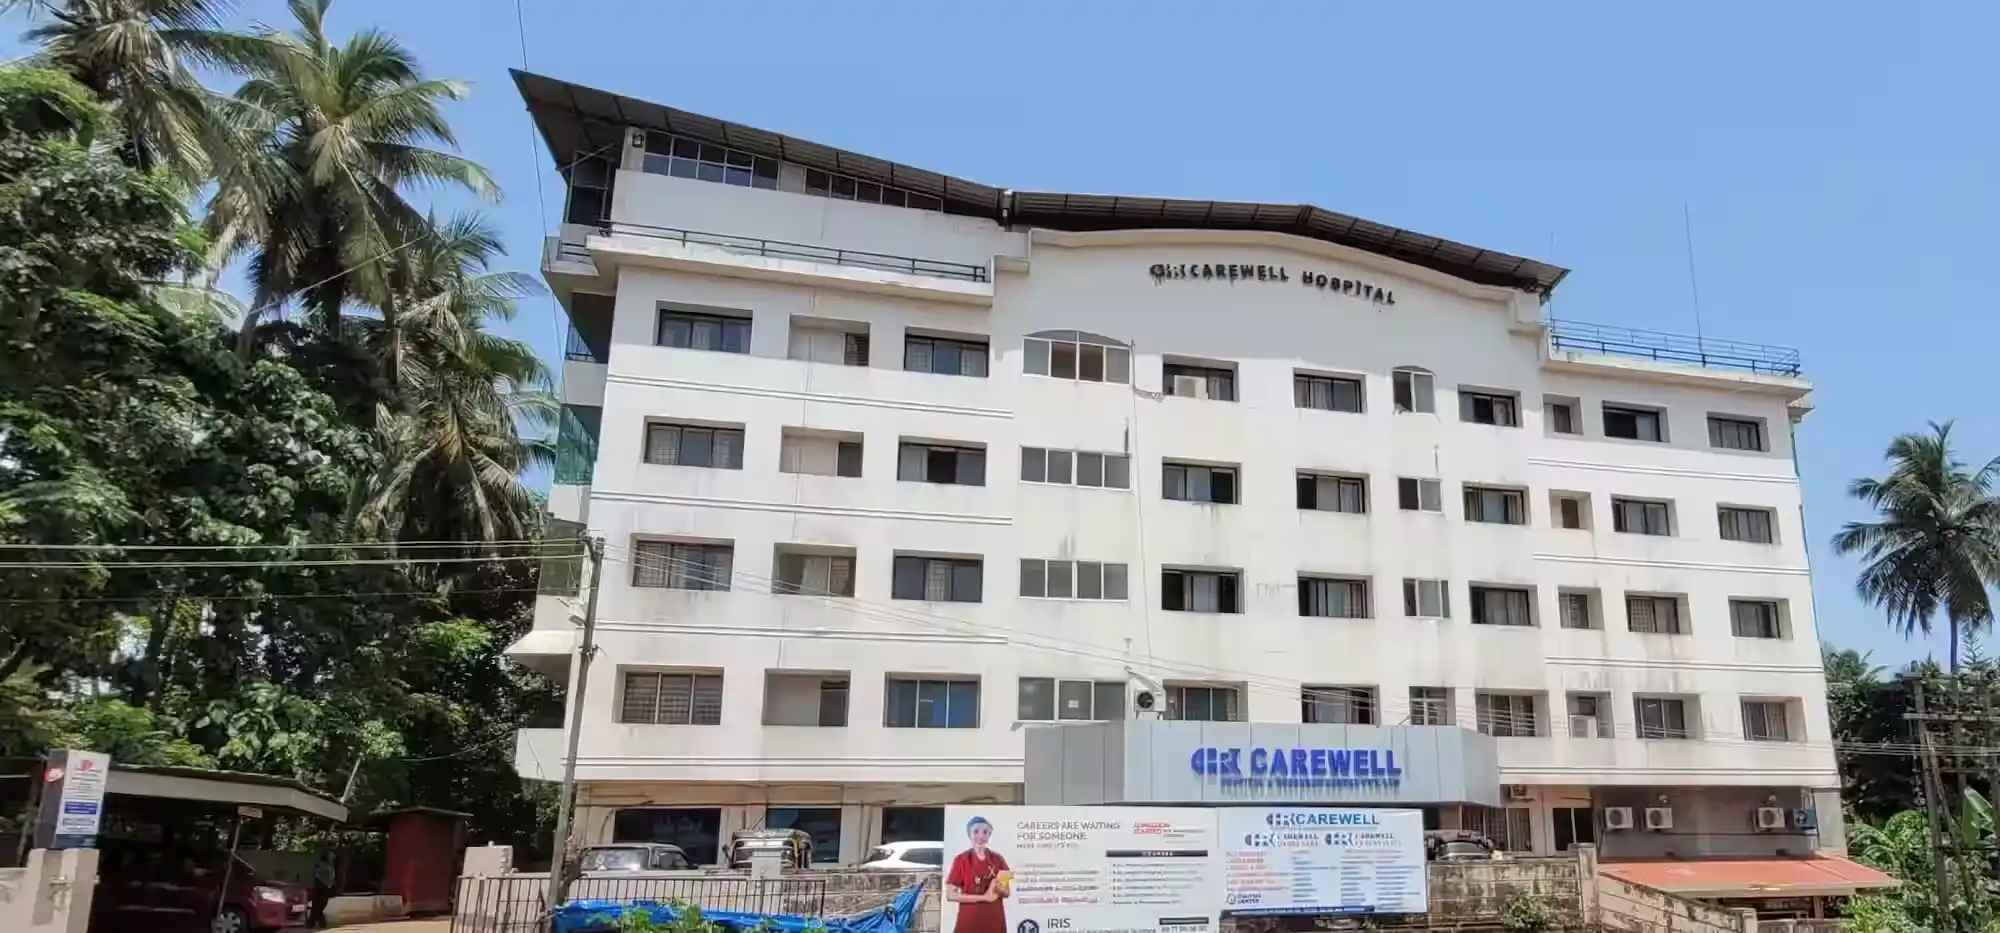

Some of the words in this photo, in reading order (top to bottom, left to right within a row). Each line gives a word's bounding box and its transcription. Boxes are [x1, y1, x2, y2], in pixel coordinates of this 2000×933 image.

[1190, 264, 1289, 282] CAREWELL
[1302, 271, 1396, 305] HOSPITAL
[1250, 748, 1402, 778] CAREWELL
[1295, 813, 1380, 825] CAREWELL
[1016, 821, 1060, 830] CAREERS
[1061, 821, 1080, 830] ARE
[1081, 821, 1121, 830] WAITING
[1016, 832, 1038, 841] FOR
[1046, 917, 1072, 930] IRIS
